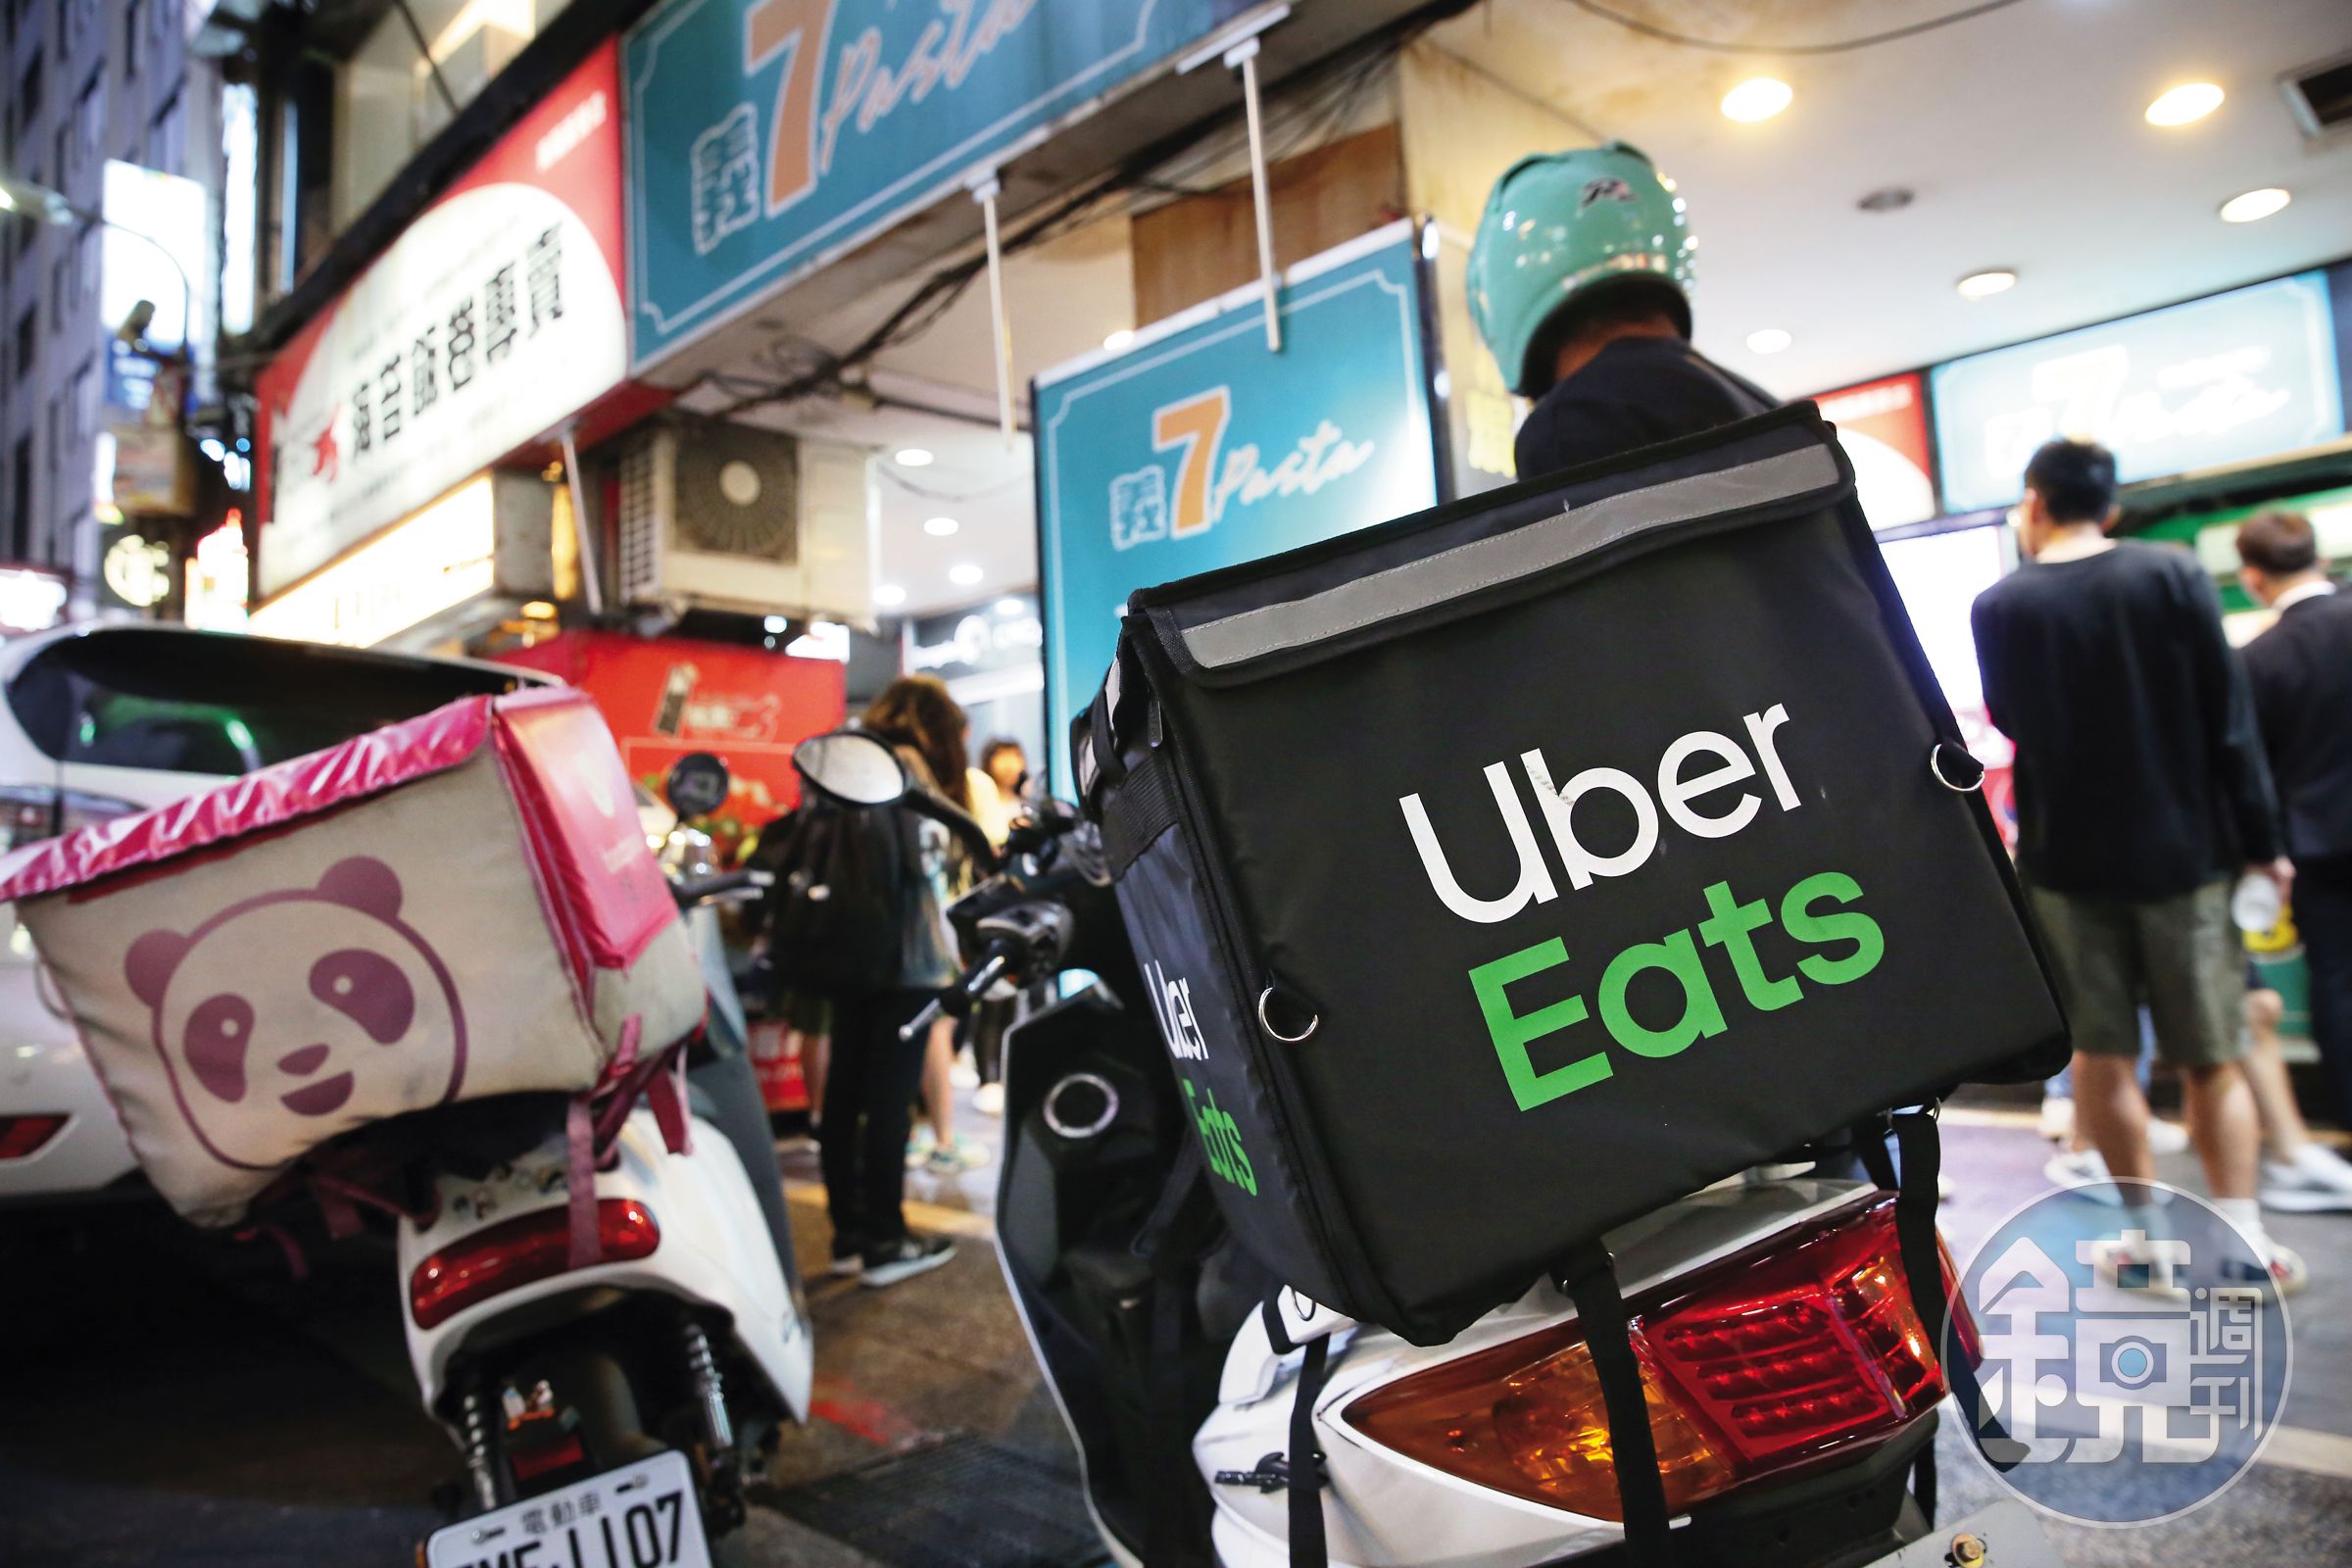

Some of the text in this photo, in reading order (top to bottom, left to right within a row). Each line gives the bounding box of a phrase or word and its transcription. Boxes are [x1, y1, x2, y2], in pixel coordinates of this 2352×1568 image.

[743, 0, 838, 220] 7
[1152, 383, 1232, 540] 7
[1212, 418, 1374, 523] Pasta
[1399, 703, 1800, 923] Uber
[1468, 871, 1886, 1112] Eats
[1182, 1078, 1257, 1197] Eats
[519, 1492, 601, 1536] 電動車
